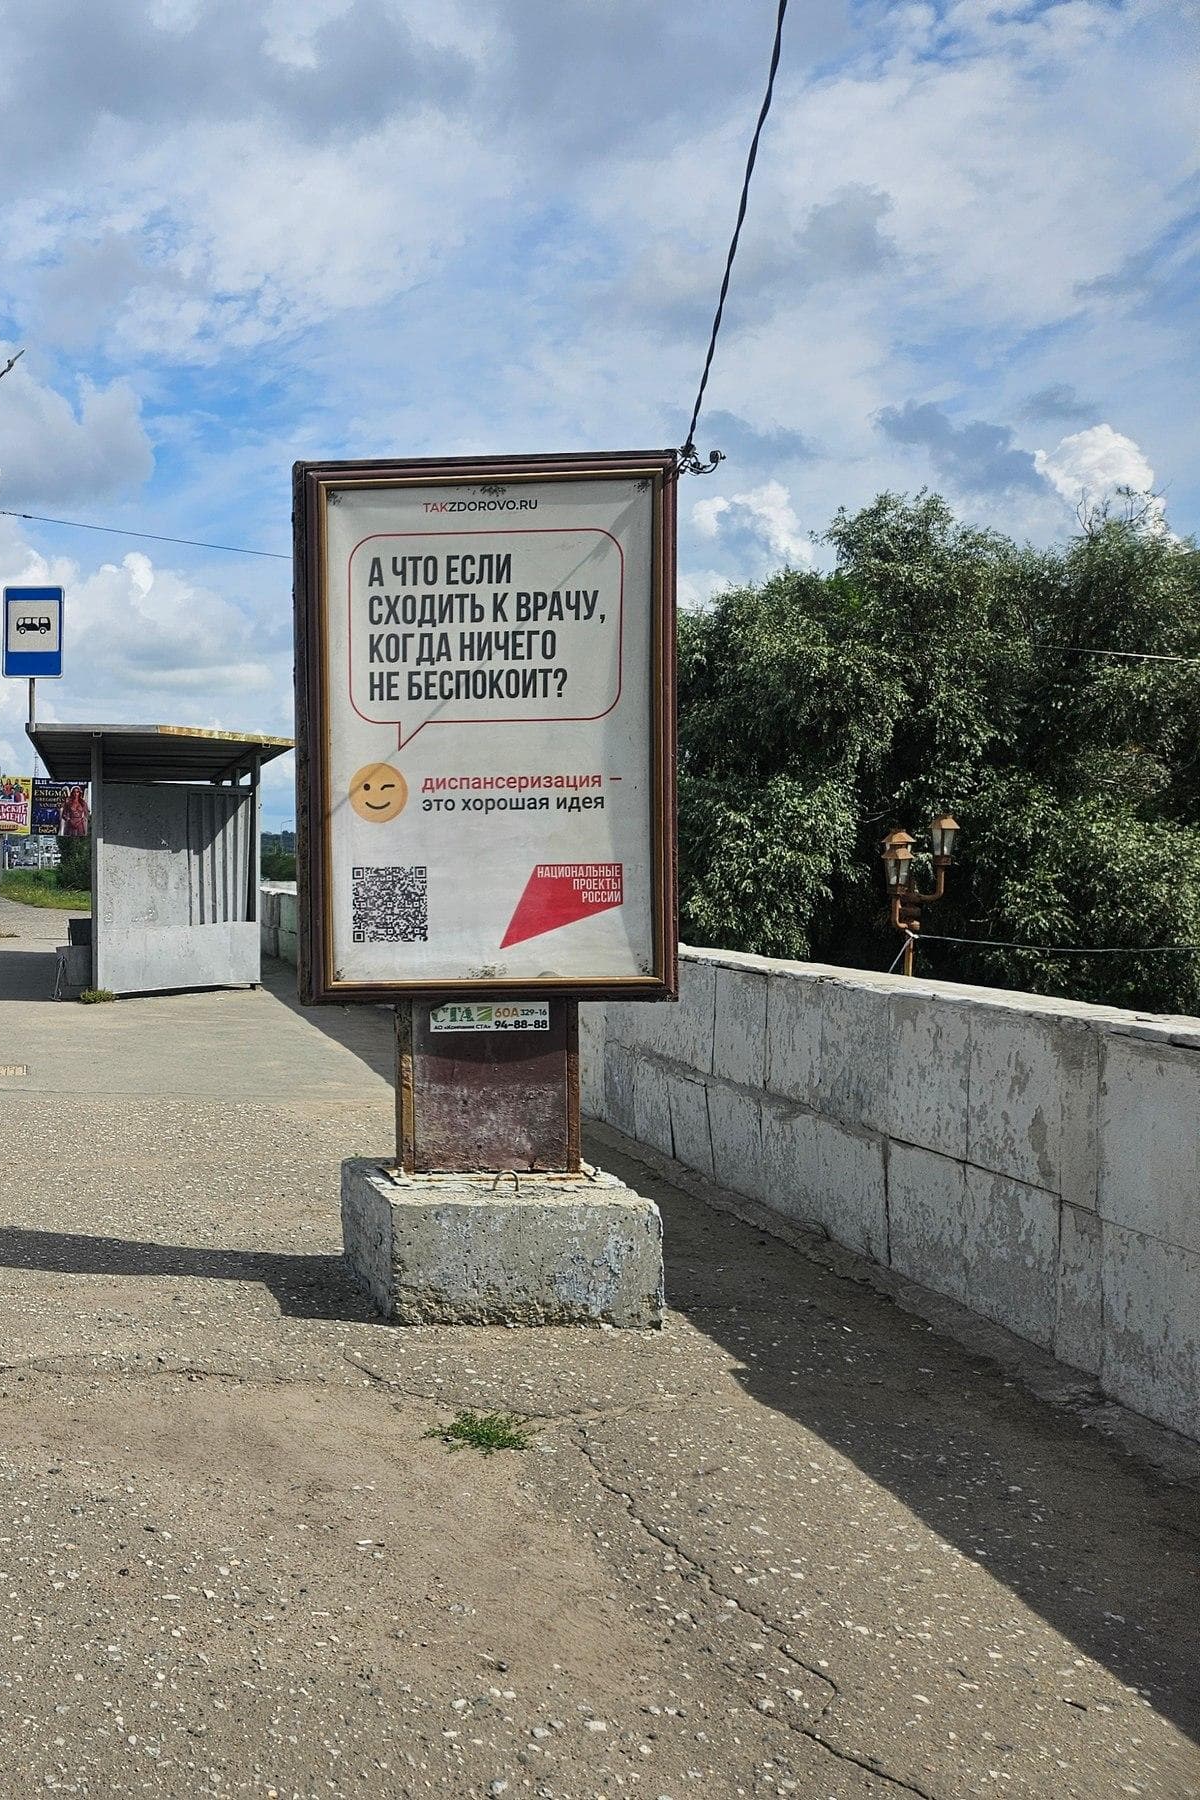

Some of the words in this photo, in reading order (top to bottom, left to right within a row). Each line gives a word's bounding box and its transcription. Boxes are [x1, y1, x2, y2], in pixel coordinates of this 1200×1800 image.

[423, 499, 538, 513] TAKZDOROVO.RU
[368, 557, 384, 587] А
[391, 555, 438, 586] ЧТО
[446, 554, 512, 585] ЕСЛИ
[368, 593, 485, 628] СХОДИТЬ
[492, 592, 509, 623] К
[516, 590, 606, 624] ВРАЧУ,
[368, 632, 452, 666] КОГДА
[459, 630, 556, 662] НИЧЕГО
[368, 671, 400, 701] НЕ
[407, 668, 568, 700] БЕСПОКОИТ?
[422, 774, 602, 793] диспансеризация
[34, 789, 67, 798] ENIGMA
[422, 798, 456, 811] это
[461, 796, 550, 814] хорошая
[556, 796, 605, 812] идея
[537, 865, 620, 879] НАЦИОНАЛЬНЫЕ
[573, 878, 621, 890] ПРОЕКТЫ
[582, 891, 621, 903] РОССИИ
[431, 1006, 474, 1022] СТА
[520, 1008, 547, 1017] 329-16
[494, 1020, 548, 1029] 94-88-88
